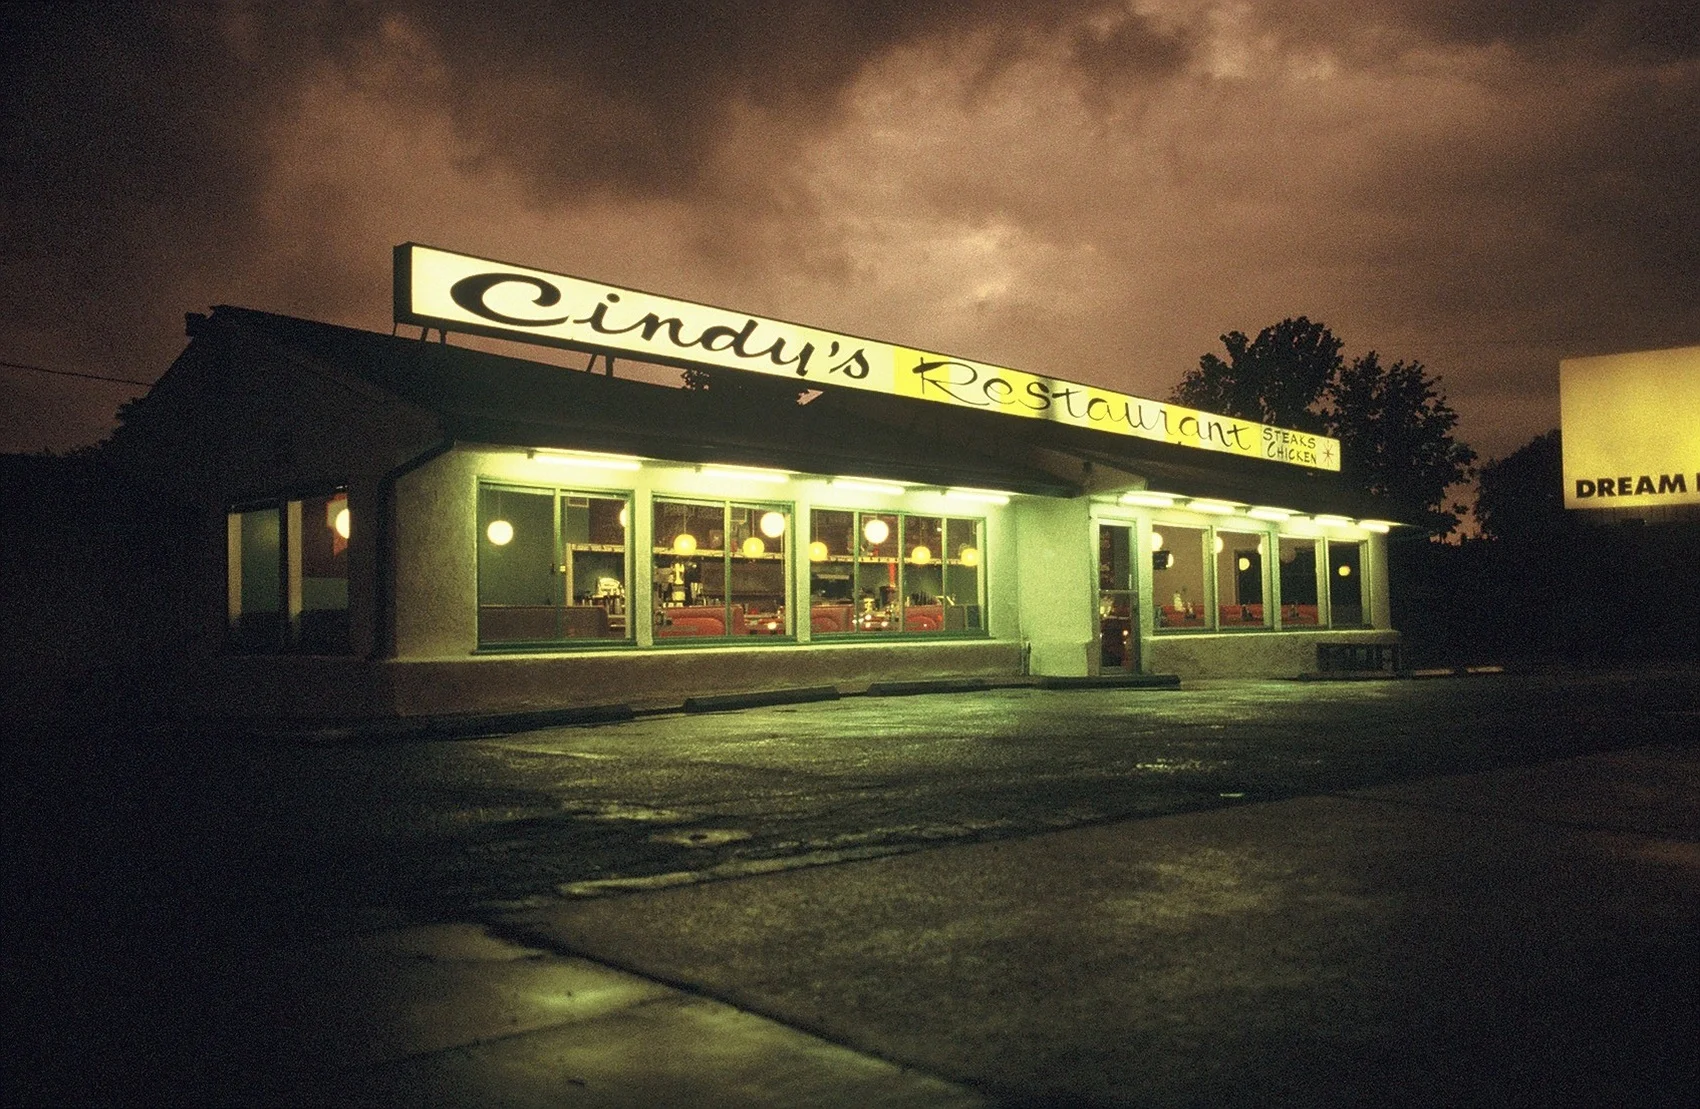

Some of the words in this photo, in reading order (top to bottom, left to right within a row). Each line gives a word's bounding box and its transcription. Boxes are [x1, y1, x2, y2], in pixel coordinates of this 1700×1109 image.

[450, 272, 870, 380] Cindy's
[912, 357, 1252, 451] Restaurant
[1262, 427, 1317, 450] STEAKS
[1266, 441, 1318, 465] CHICKEN
[1575, 473, 1688, 499] DREAM
